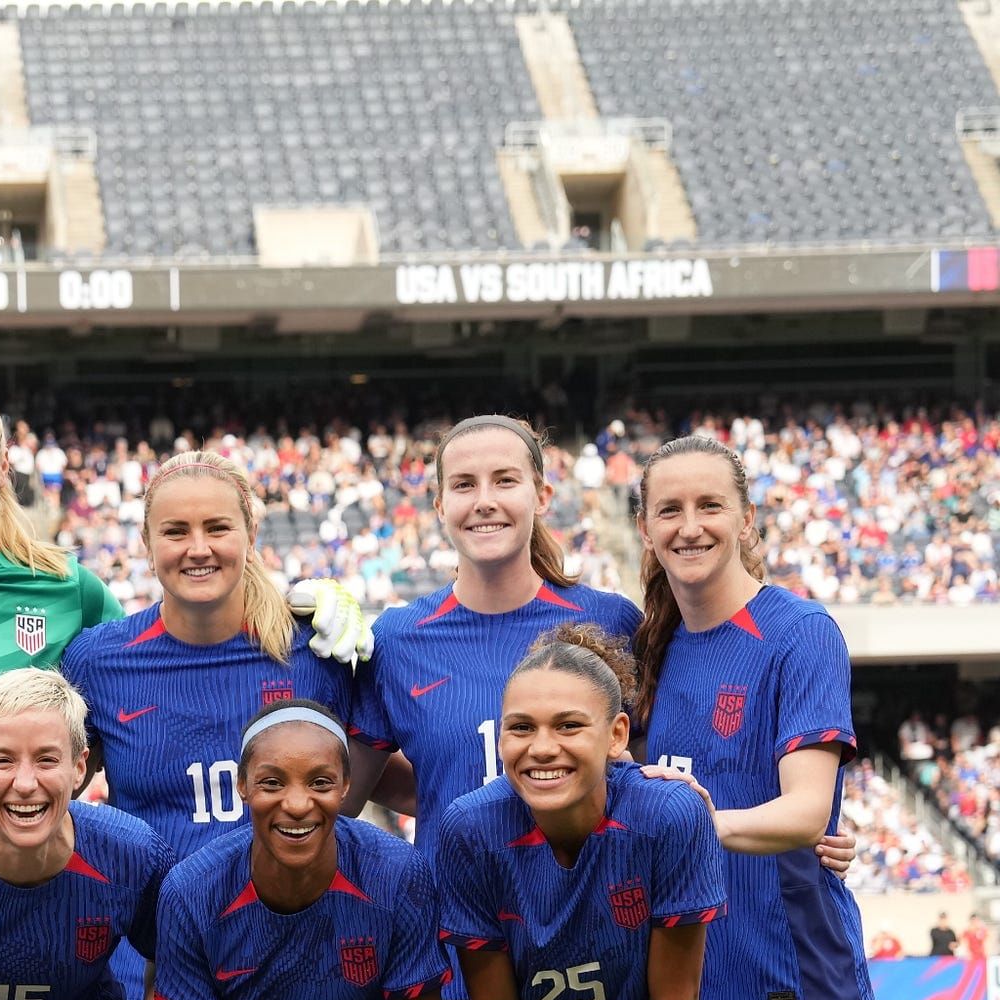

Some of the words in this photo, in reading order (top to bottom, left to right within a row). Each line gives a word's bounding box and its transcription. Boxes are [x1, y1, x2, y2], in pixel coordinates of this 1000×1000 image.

[59, 270, 133, 309] 0:00
[396, 265, 457, 303] USA
[460, 264, 502, 302] VS
[507, 262, 605, 301] SOUTH
[608, 259, 713, 299] AFRICA
[17, 616, 44, 633] USA
[719, 694, 746, 713] USA
[186, 760, 244, 823] 10
[611, 888, 643, 906] USA
[79, 926, 109, 940] USA
[343, 947, 374, 963] USA
